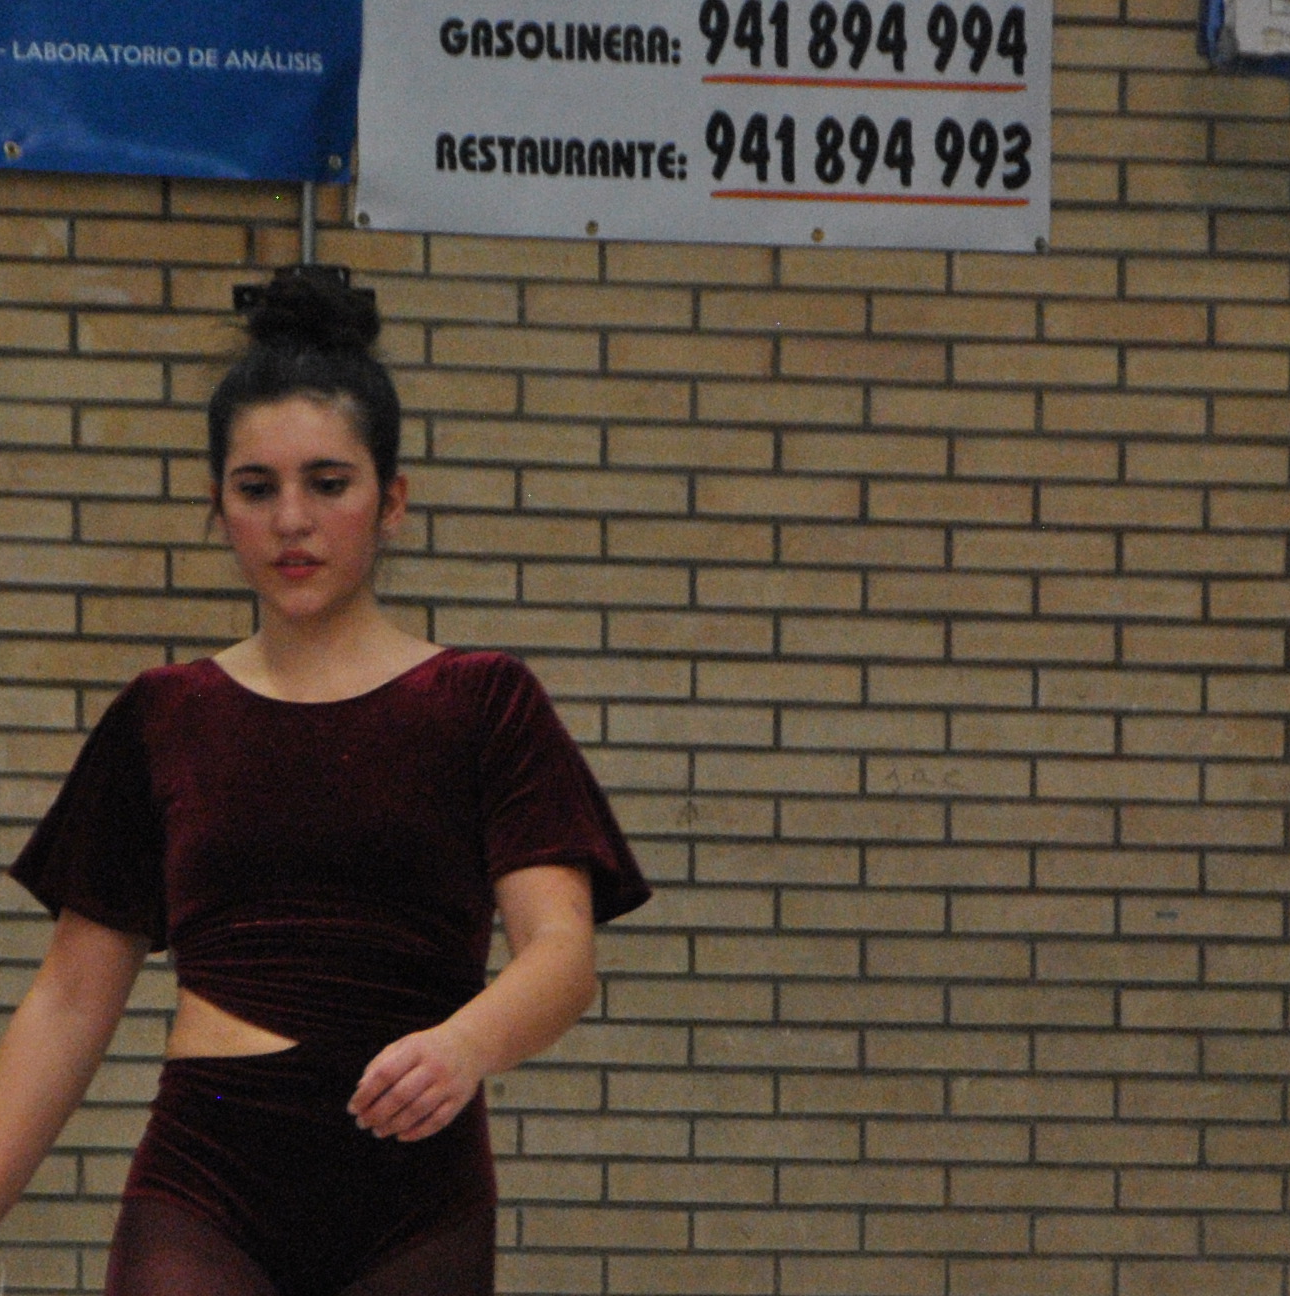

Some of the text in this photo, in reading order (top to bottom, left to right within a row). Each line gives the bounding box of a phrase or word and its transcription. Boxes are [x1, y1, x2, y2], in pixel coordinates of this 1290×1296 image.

[12, 41, 182, 68] LABORATORIO
[188, 48, 218, 68] DE
[224, 46, 324, 74] ANÁLISIS
[439, 0, 1027, 76] GASOLINERA: 941 894 994
[435, 109, 1032, 190] RESTAURANTE: 941 894 993
